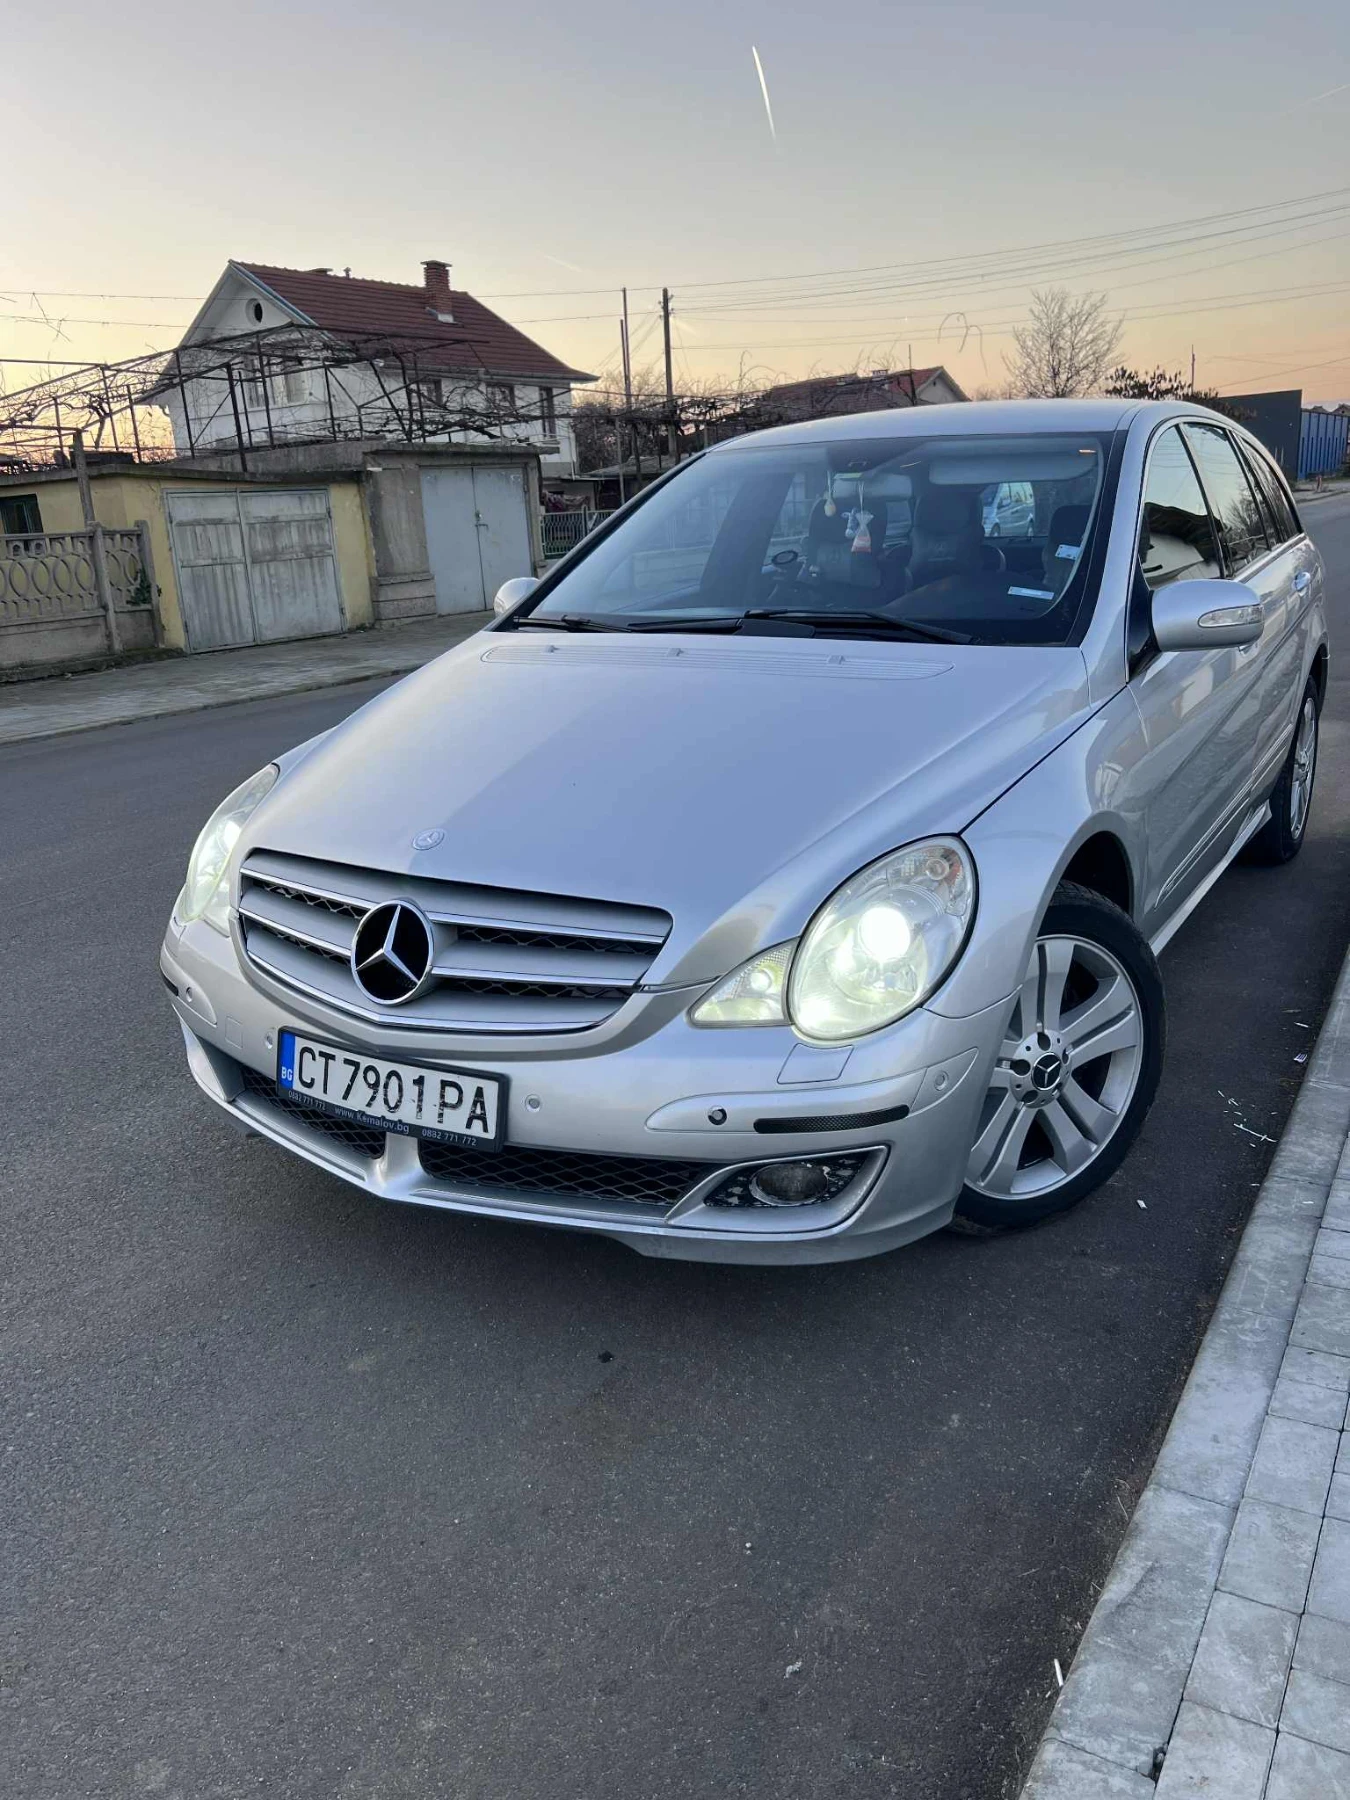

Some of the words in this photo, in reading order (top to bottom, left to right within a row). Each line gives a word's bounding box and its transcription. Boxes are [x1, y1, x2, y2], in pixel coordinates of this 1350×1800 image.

[281, 1066, 293, 1081] BG
[334, 1107, 410, 1135] wwwKemalov.bg
[444, 1132, 459, 1142] 771
